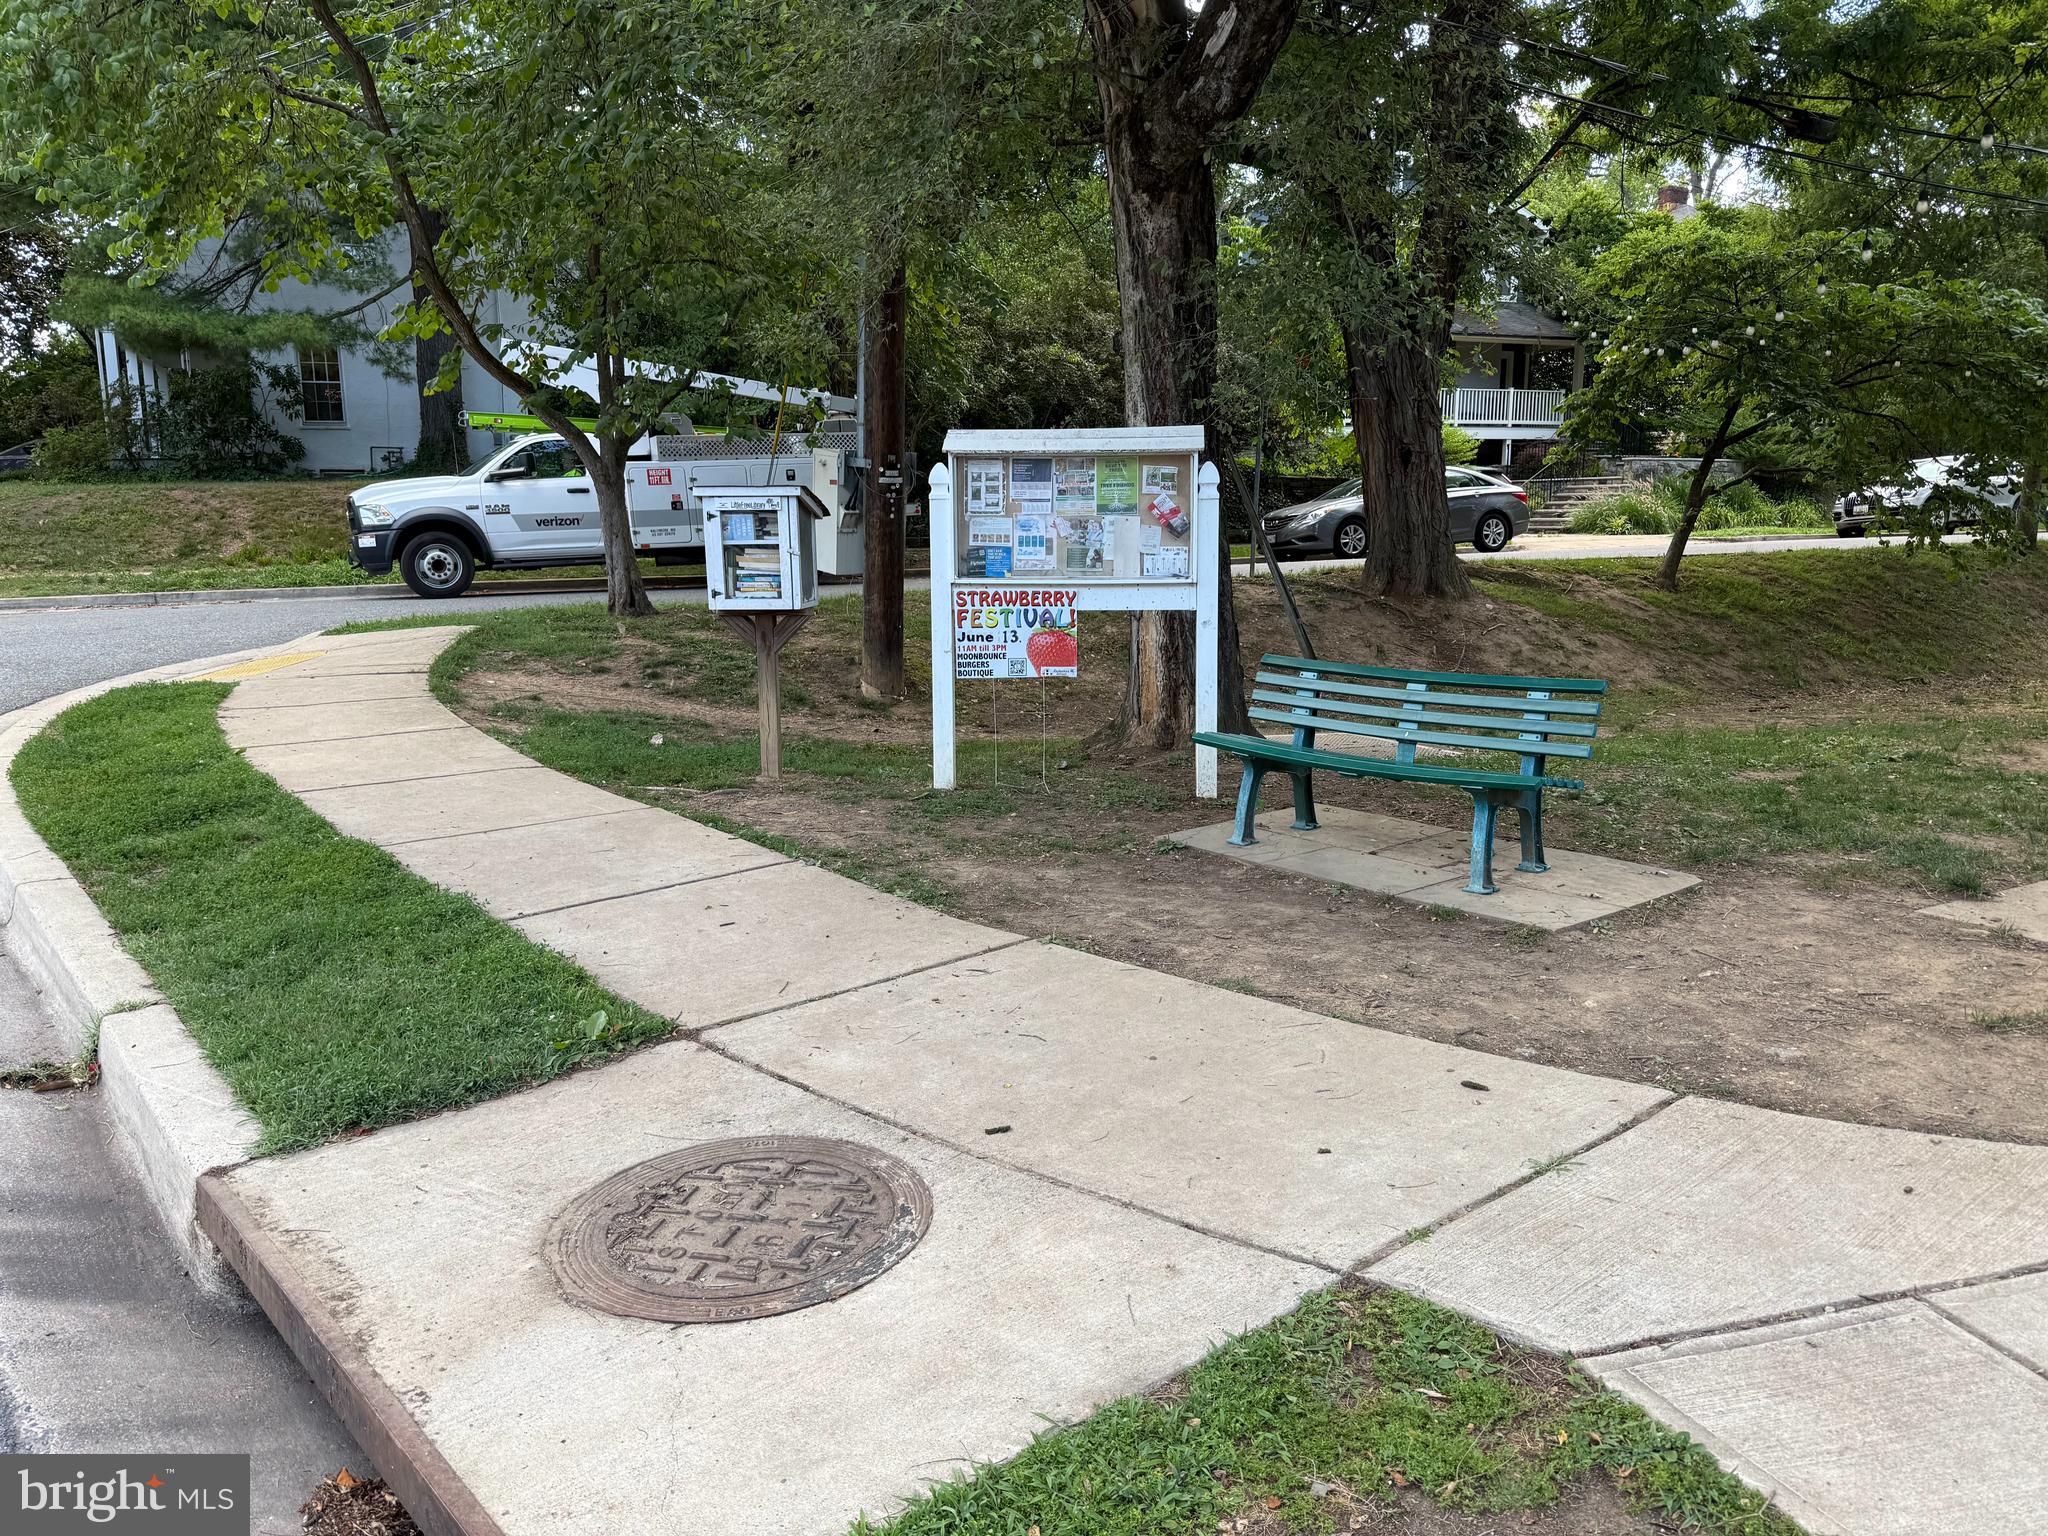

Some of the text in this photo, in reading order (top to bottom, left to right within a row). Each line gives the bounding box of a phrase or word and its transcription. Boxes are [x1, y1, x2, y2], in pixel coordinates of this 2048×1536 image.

[536, 516, 580, 526] verizon
[956, 590, 1077, 607] STRAWBERRY
[956, 608, 1077, 628] FESTIVAL!
[957, 630, 1022, 643] June 13.
[957, 652, 1007, 660] MOONBOUNCE
[957, 661, 990, 669] BURGERS
[957, 669, 994, 677] BOUTIQUE
